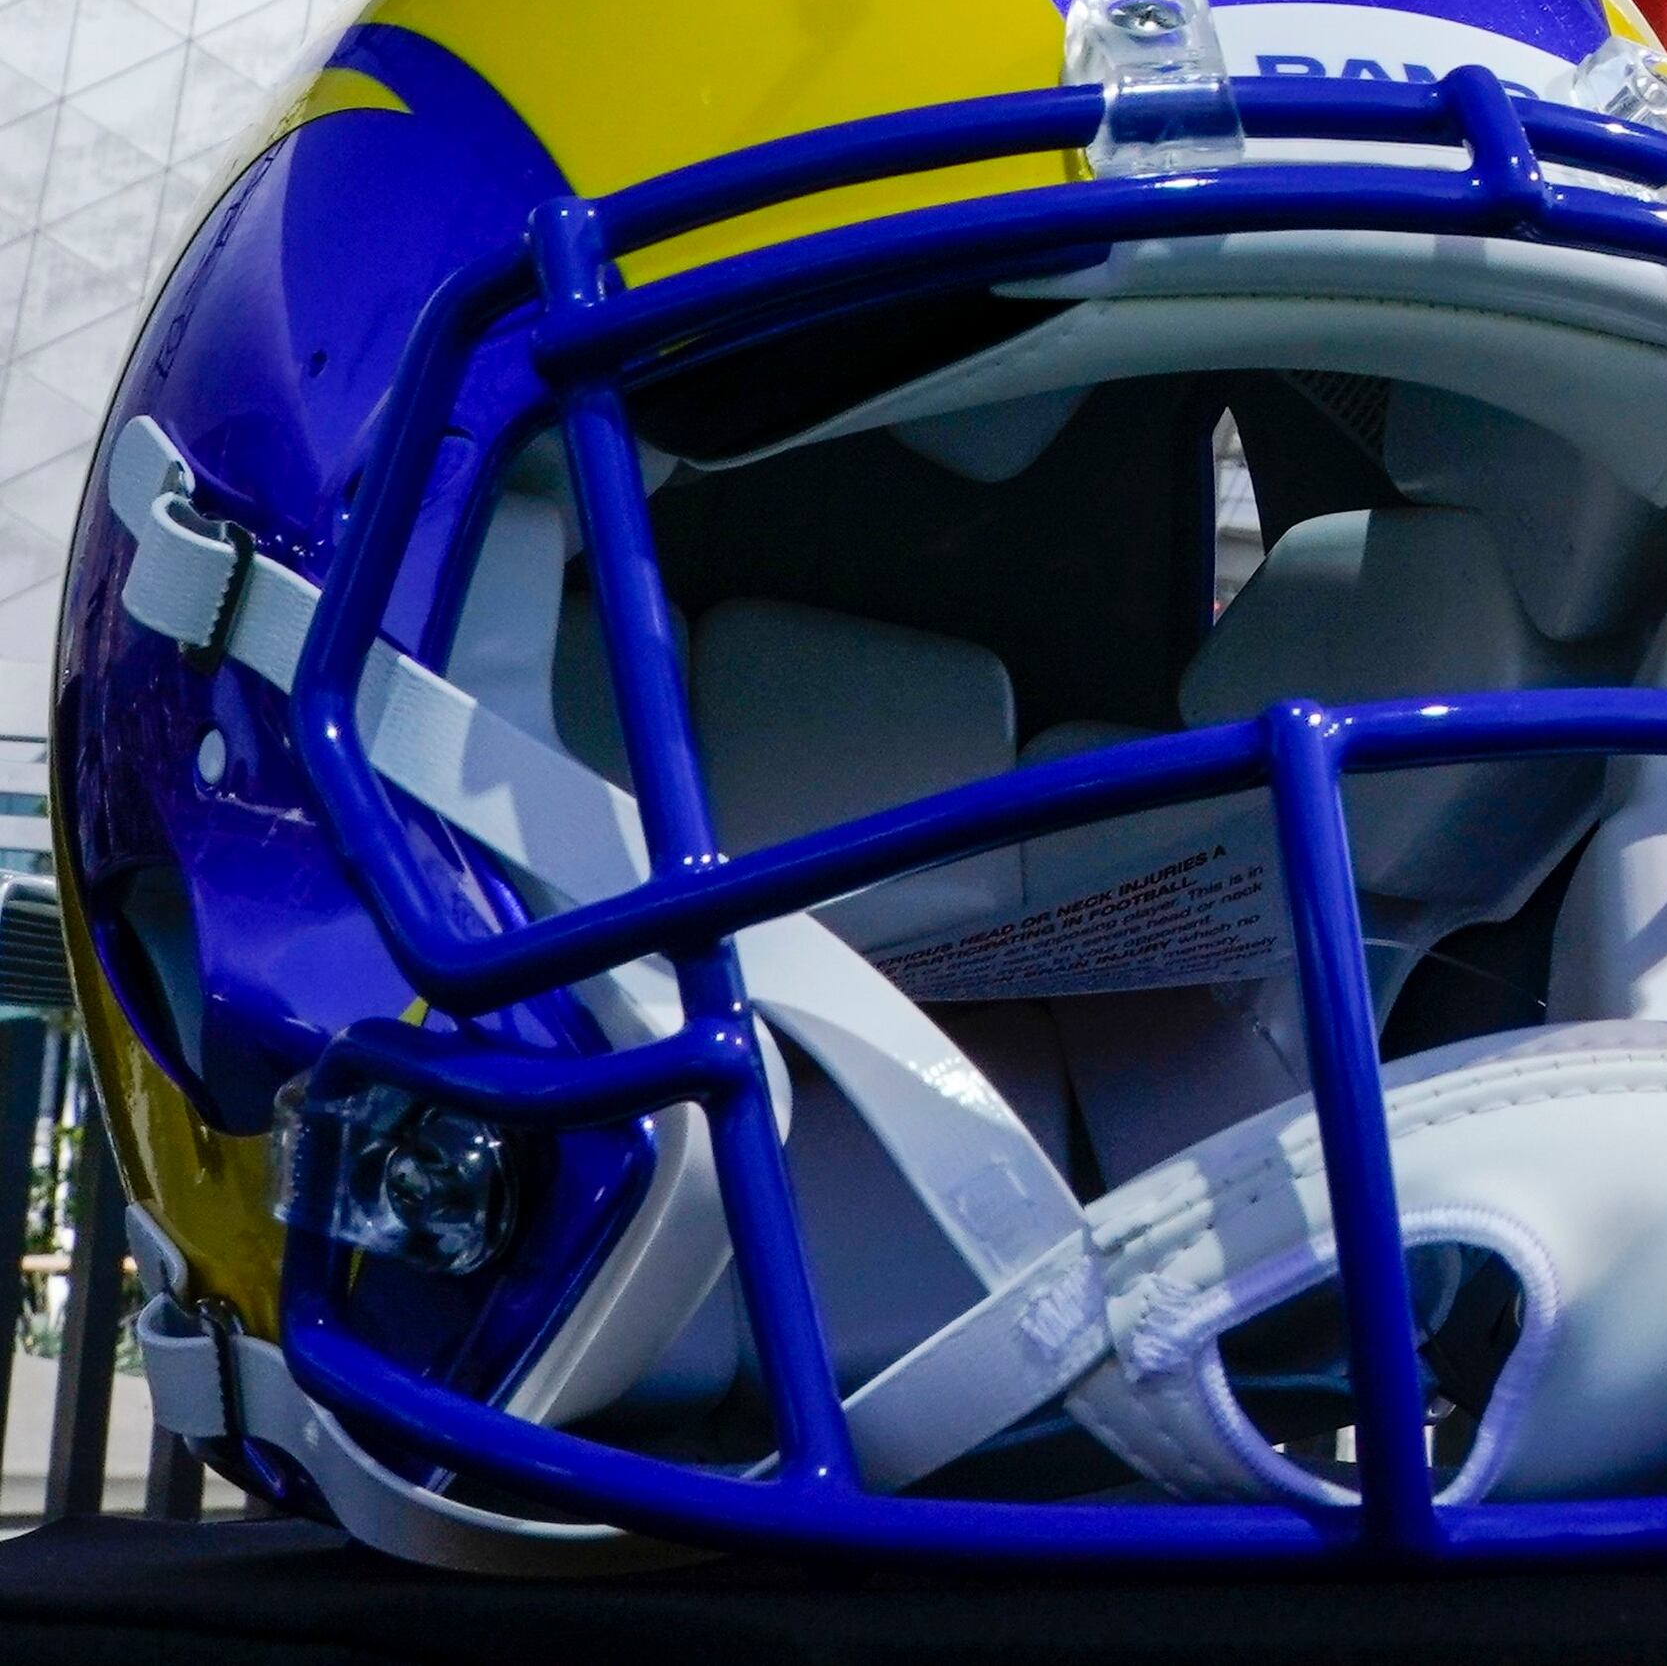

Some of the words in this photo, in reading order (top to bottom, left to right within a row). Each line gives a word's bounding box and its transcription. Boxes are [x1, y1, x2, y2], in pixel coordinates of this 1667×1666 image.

[959, 924, 1015, 947] HEAD
[1021, 911, 1051, 929] OR
[1056, 890, 1112, 918] NECK
[1118, 852, 1208, 897] INJURIES
[1212, 845, 1227, 860] A
[1188, 883, 1223, 901] This
[1230, 873, 1244, 886] is
[1248, 864, 1264, 880] in
[1221, 882, 1263, 905] neck
[1062, 915, 1083, 930] IN
[1096, 939, 1172, 969] INJURY
